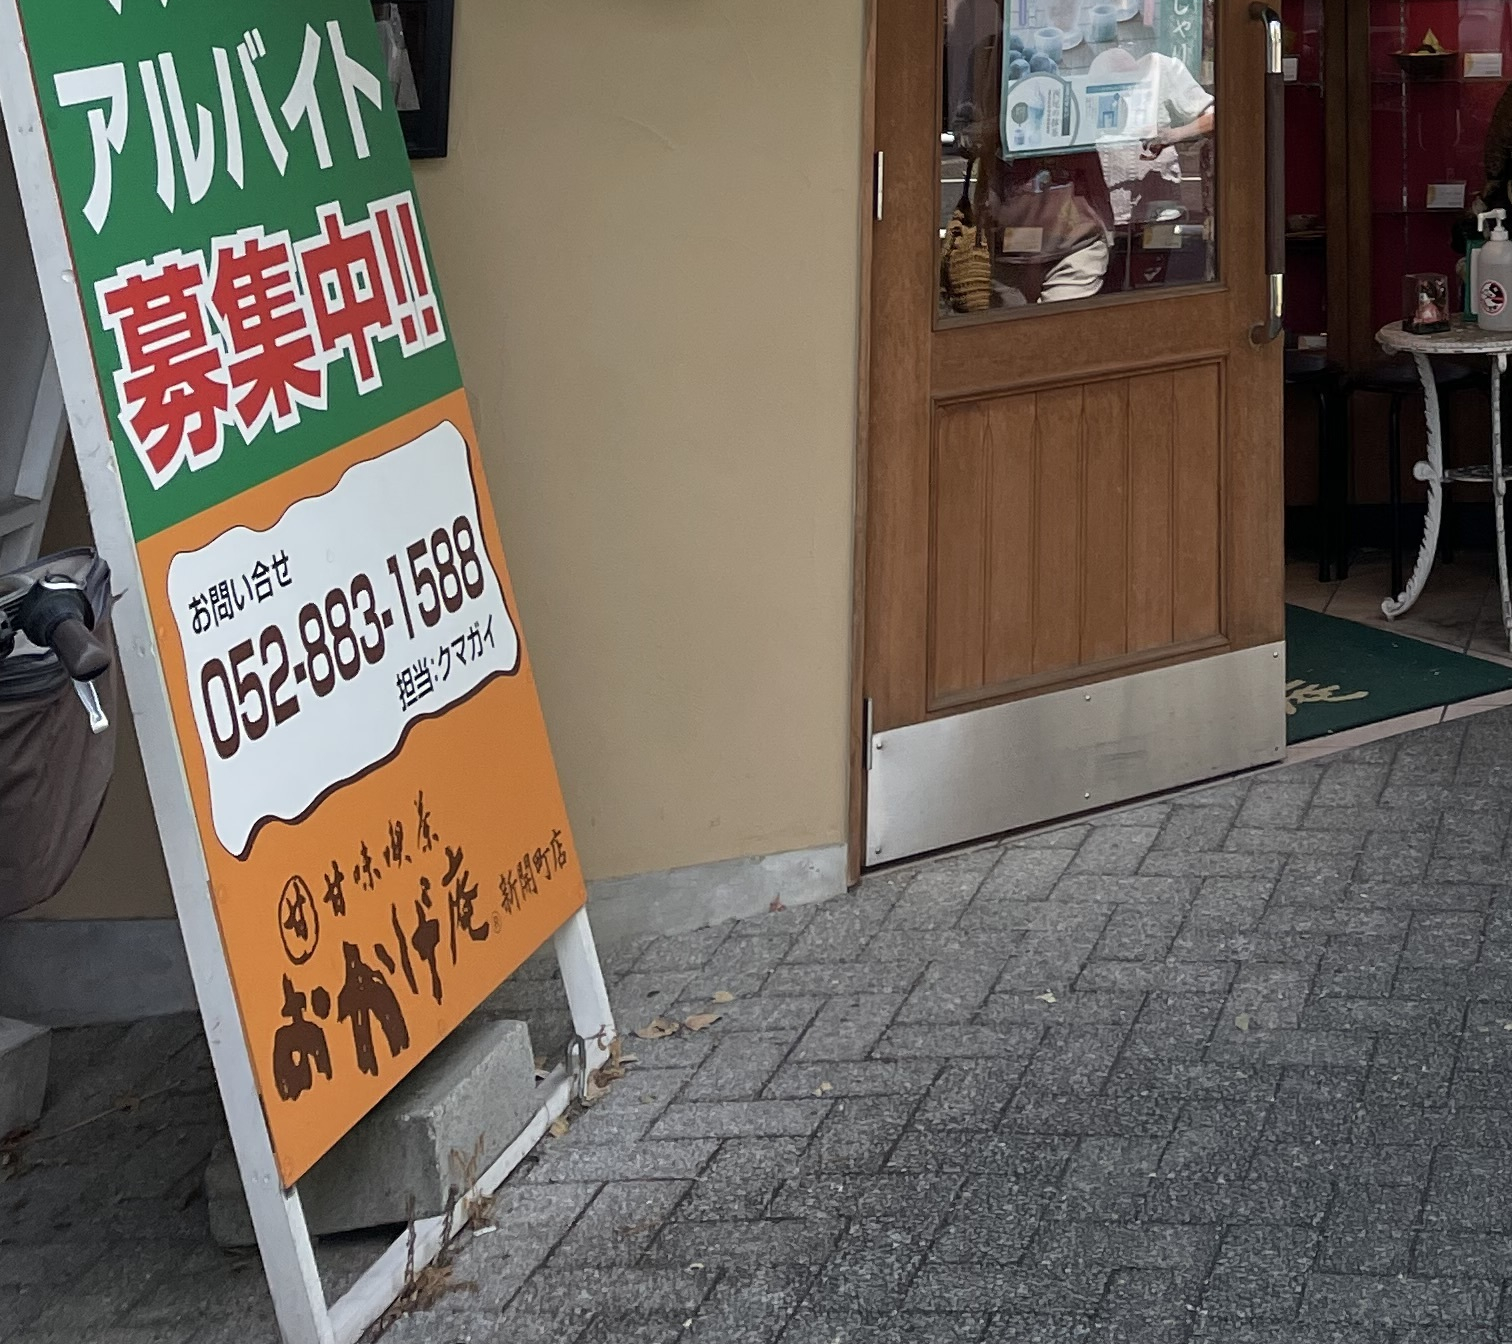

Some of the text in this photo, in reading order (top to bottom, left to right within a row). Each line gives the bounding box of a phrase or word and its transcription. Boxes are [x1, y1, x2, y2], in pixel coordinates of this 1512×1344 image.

[52, 18, 383, 235] アルバイト
[94, 191, 446, 491] 募集中!!
[187, 549, 293, 635] お問い合せ
[201, 515, 484, 760] 052-883-1588
[395, 614, 497, 712] 担当:クマガイ
[322, 790, 440, 917] 甘味喫茶
[497, 829, 568, 916] 新開町店
[272, 845, 491, 1102] おかげ庵
